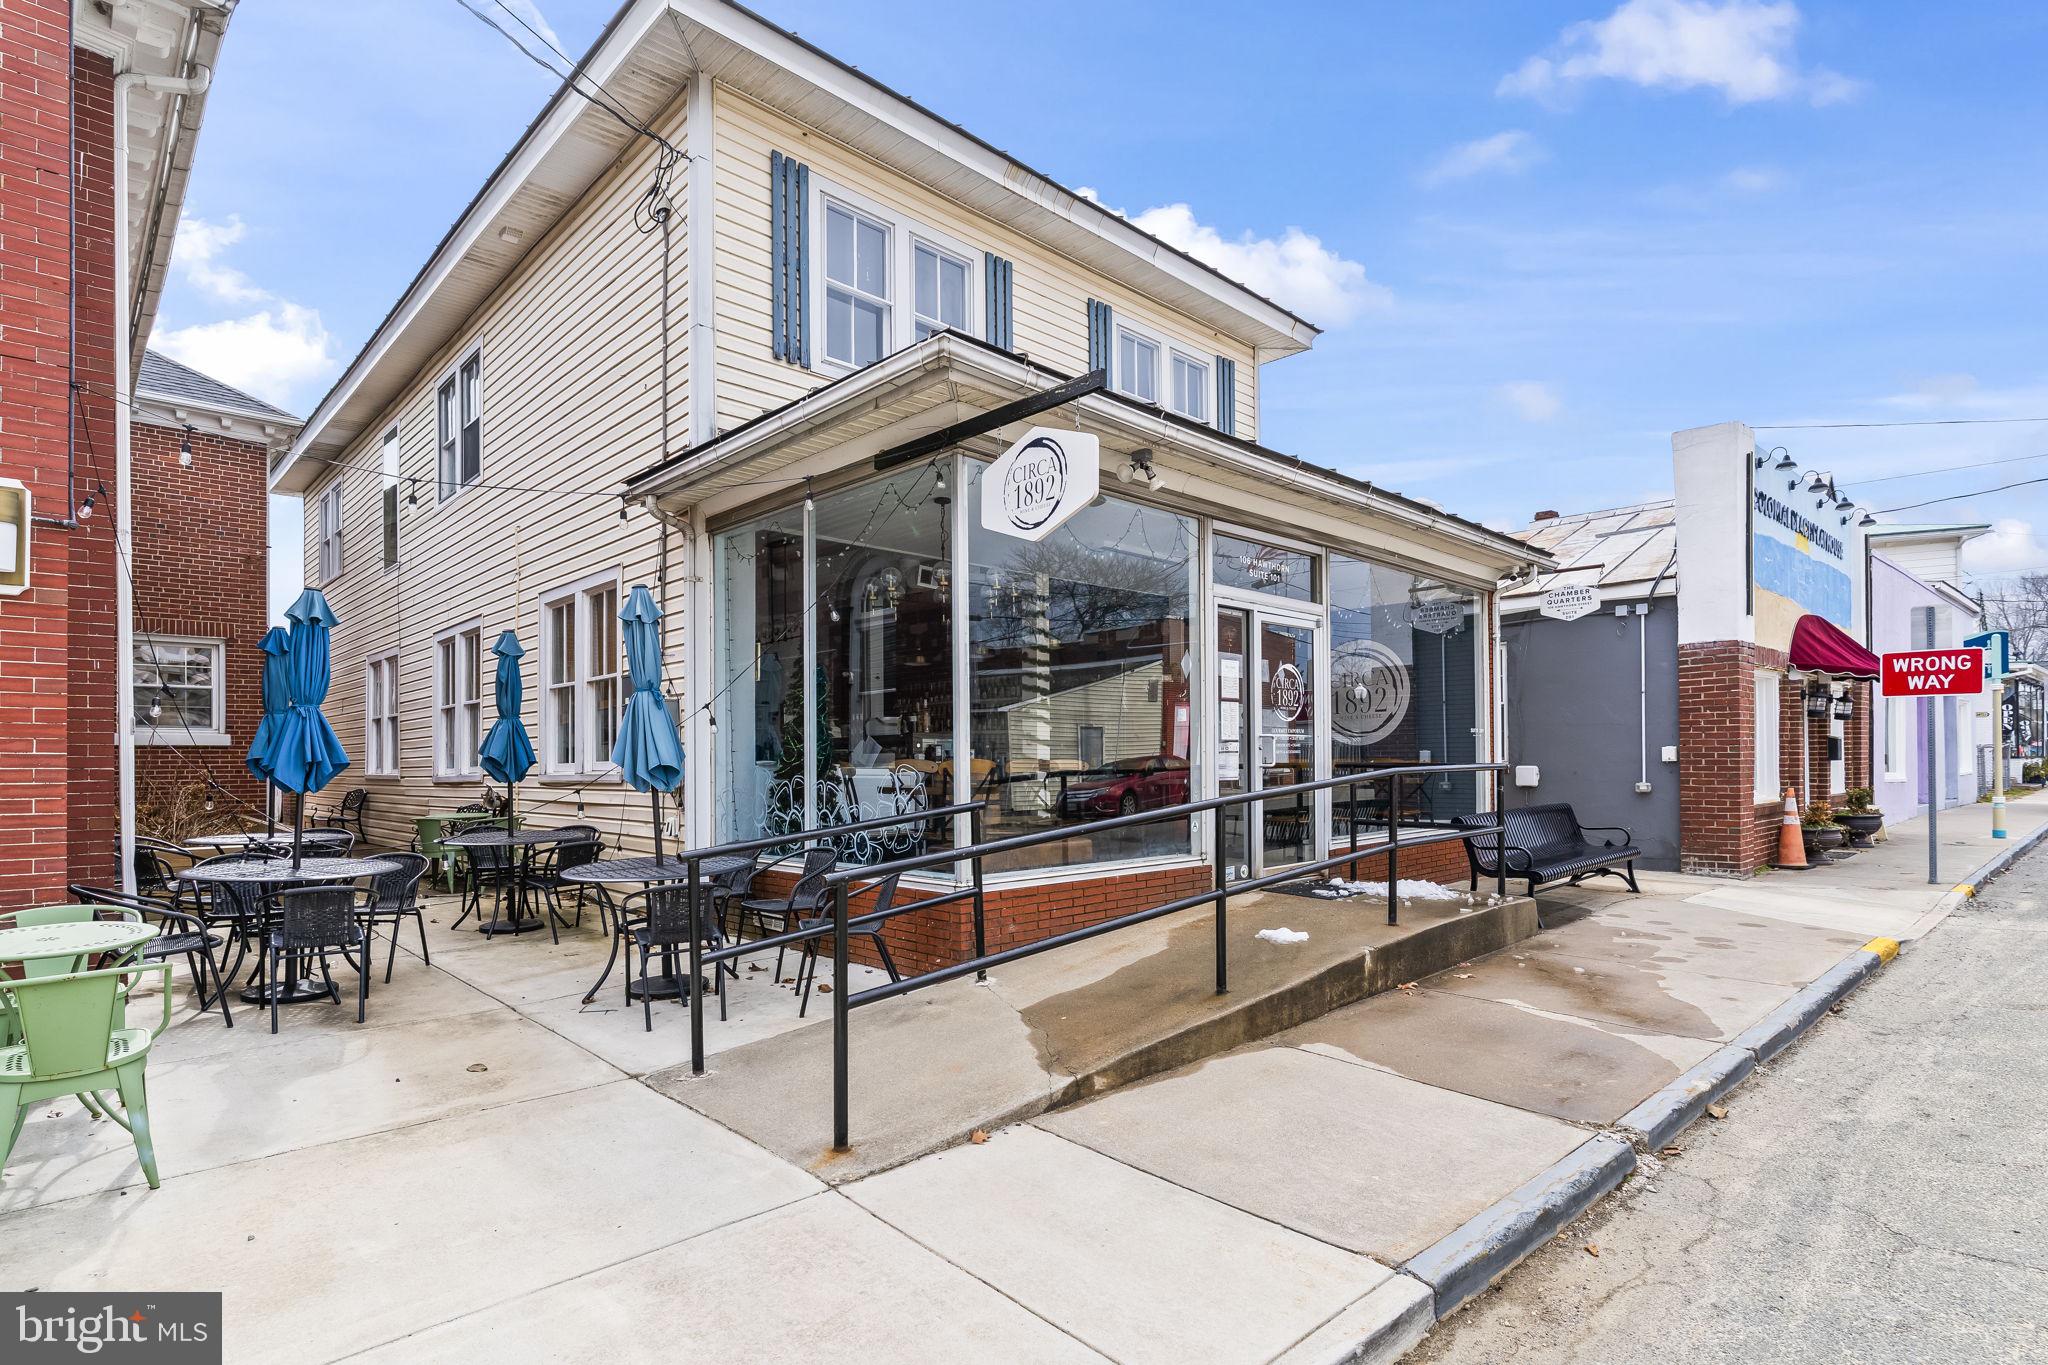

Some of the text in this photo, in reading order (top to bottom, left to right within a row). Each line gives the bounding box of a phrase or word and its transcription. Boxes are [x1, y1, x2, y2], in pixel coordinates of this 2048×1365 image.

[1012, 456, 1057, 484] CIRCA
[1013, 474, 1055, 510] 1892
[1239, 555, 1290, 574] 106 HAWTHORN
[1249, 568, 1280, 583] SUITE 101
[1546, 595, 1593, 606] QUARTERS
[1548, 588, 1591, 599] CHAMBER
[1892, 654, 1972, 673] WRONG
[1275, 678, 1300, 691] CIRCA
[1907, 673, 1955, 690] WAY
[1276, 690, 1300, 707] 1892
[1331, 687, 1388, 715] 1892
